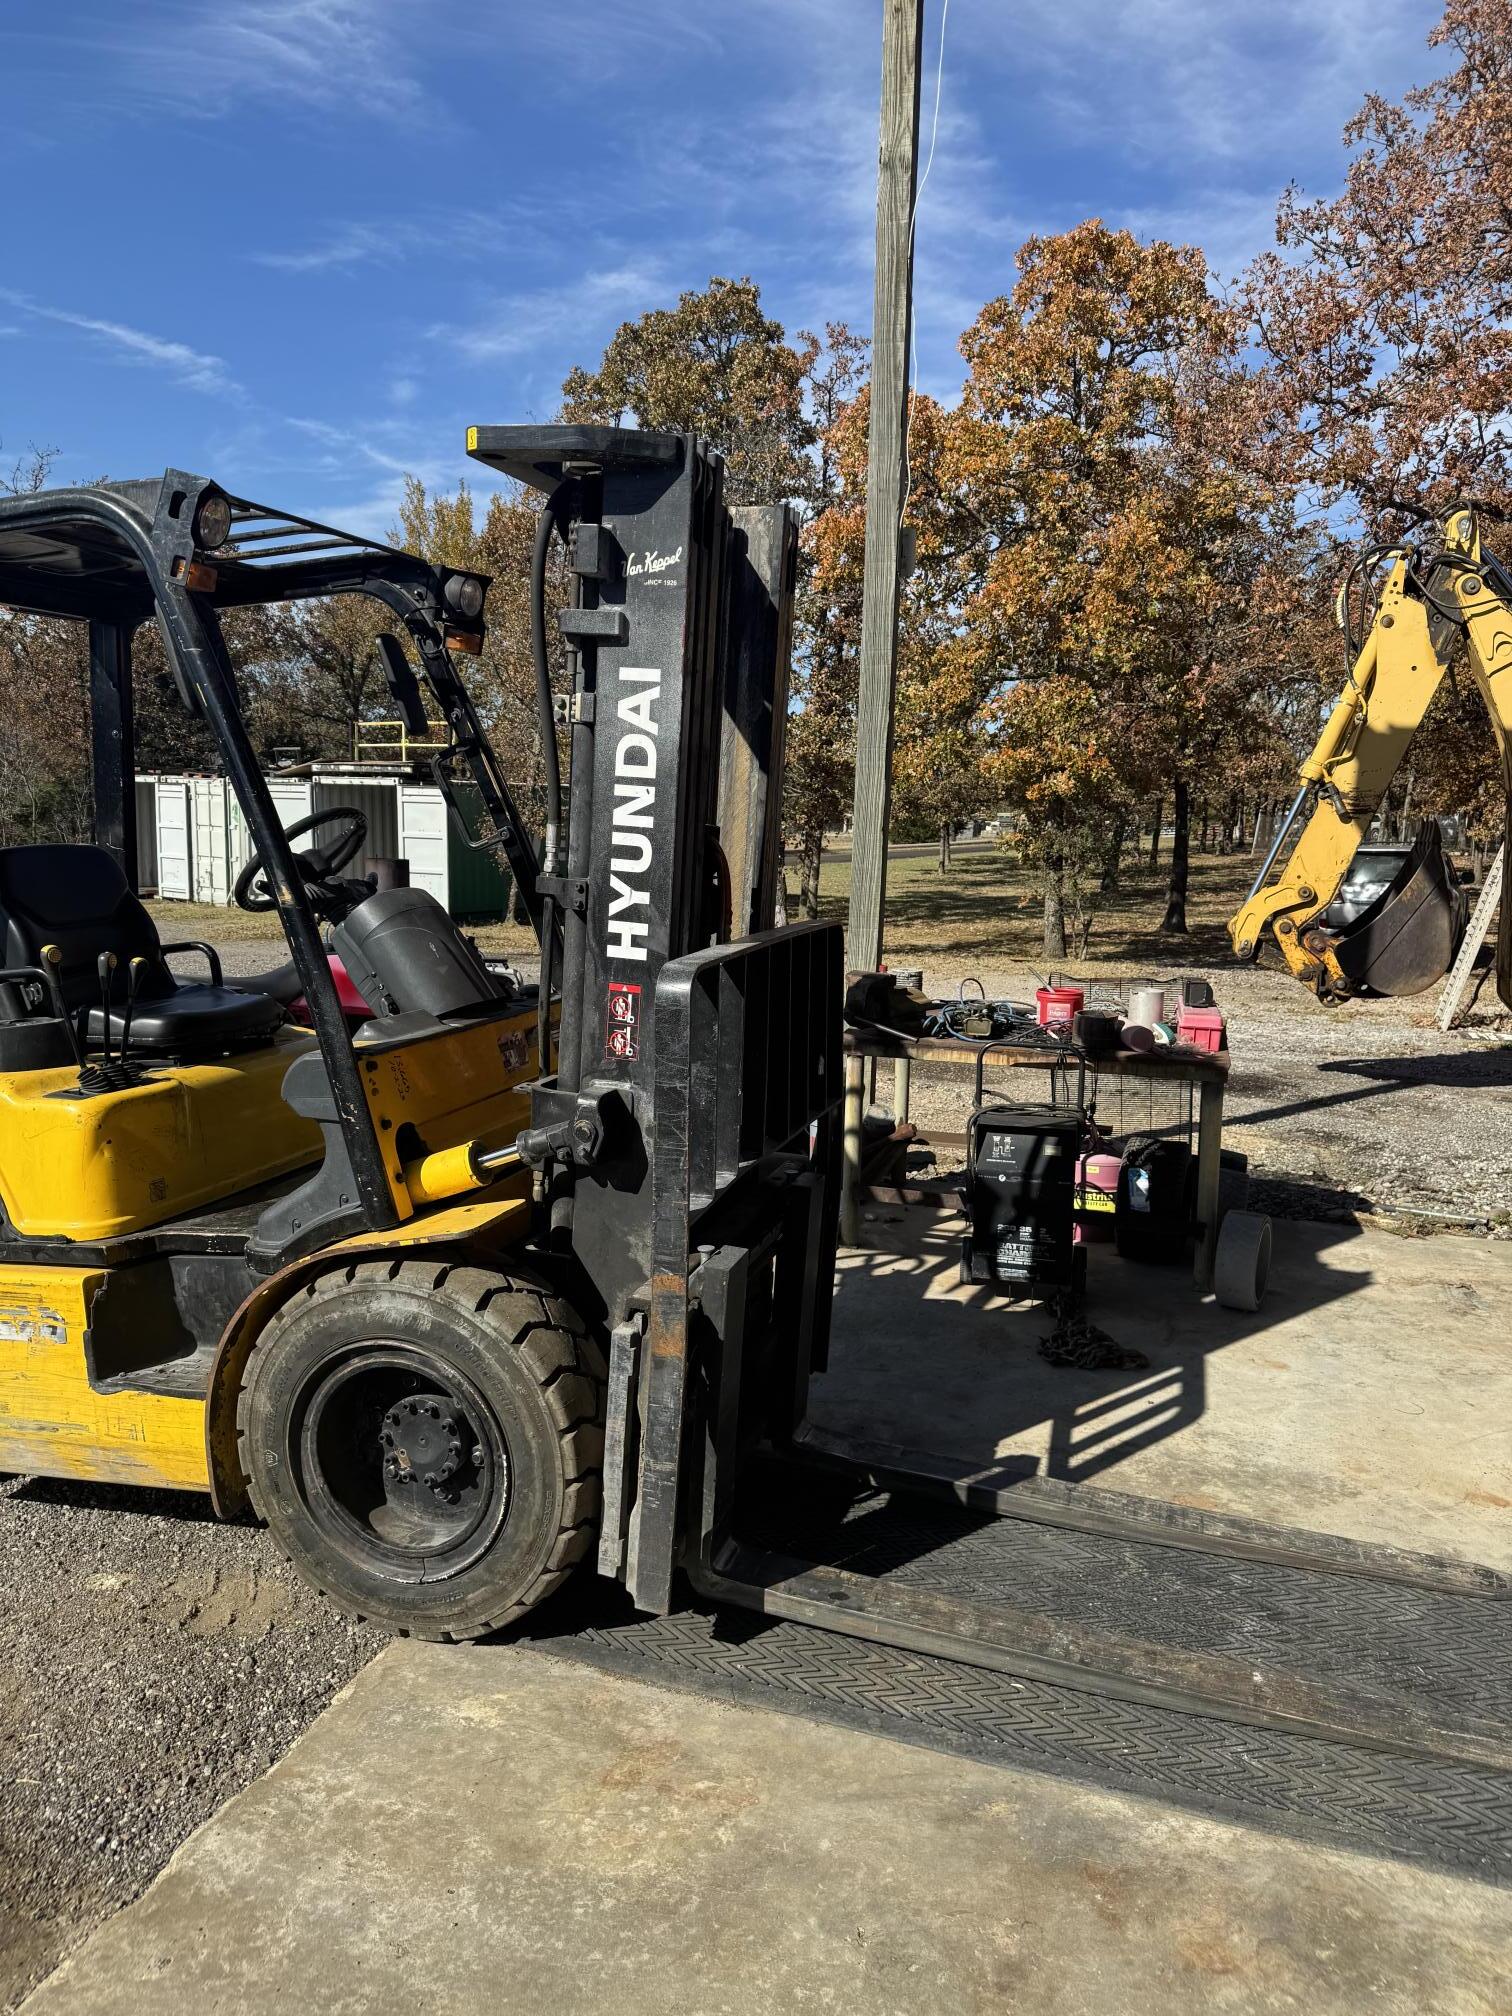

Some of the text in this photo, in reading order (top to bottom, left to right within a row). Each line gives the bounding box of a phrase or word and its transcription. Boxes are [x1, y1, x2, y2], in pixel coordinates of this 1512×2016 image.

[621, 546, 682, 577] Van Keppel
[606, 666, 662, 961] HYUNDAI
